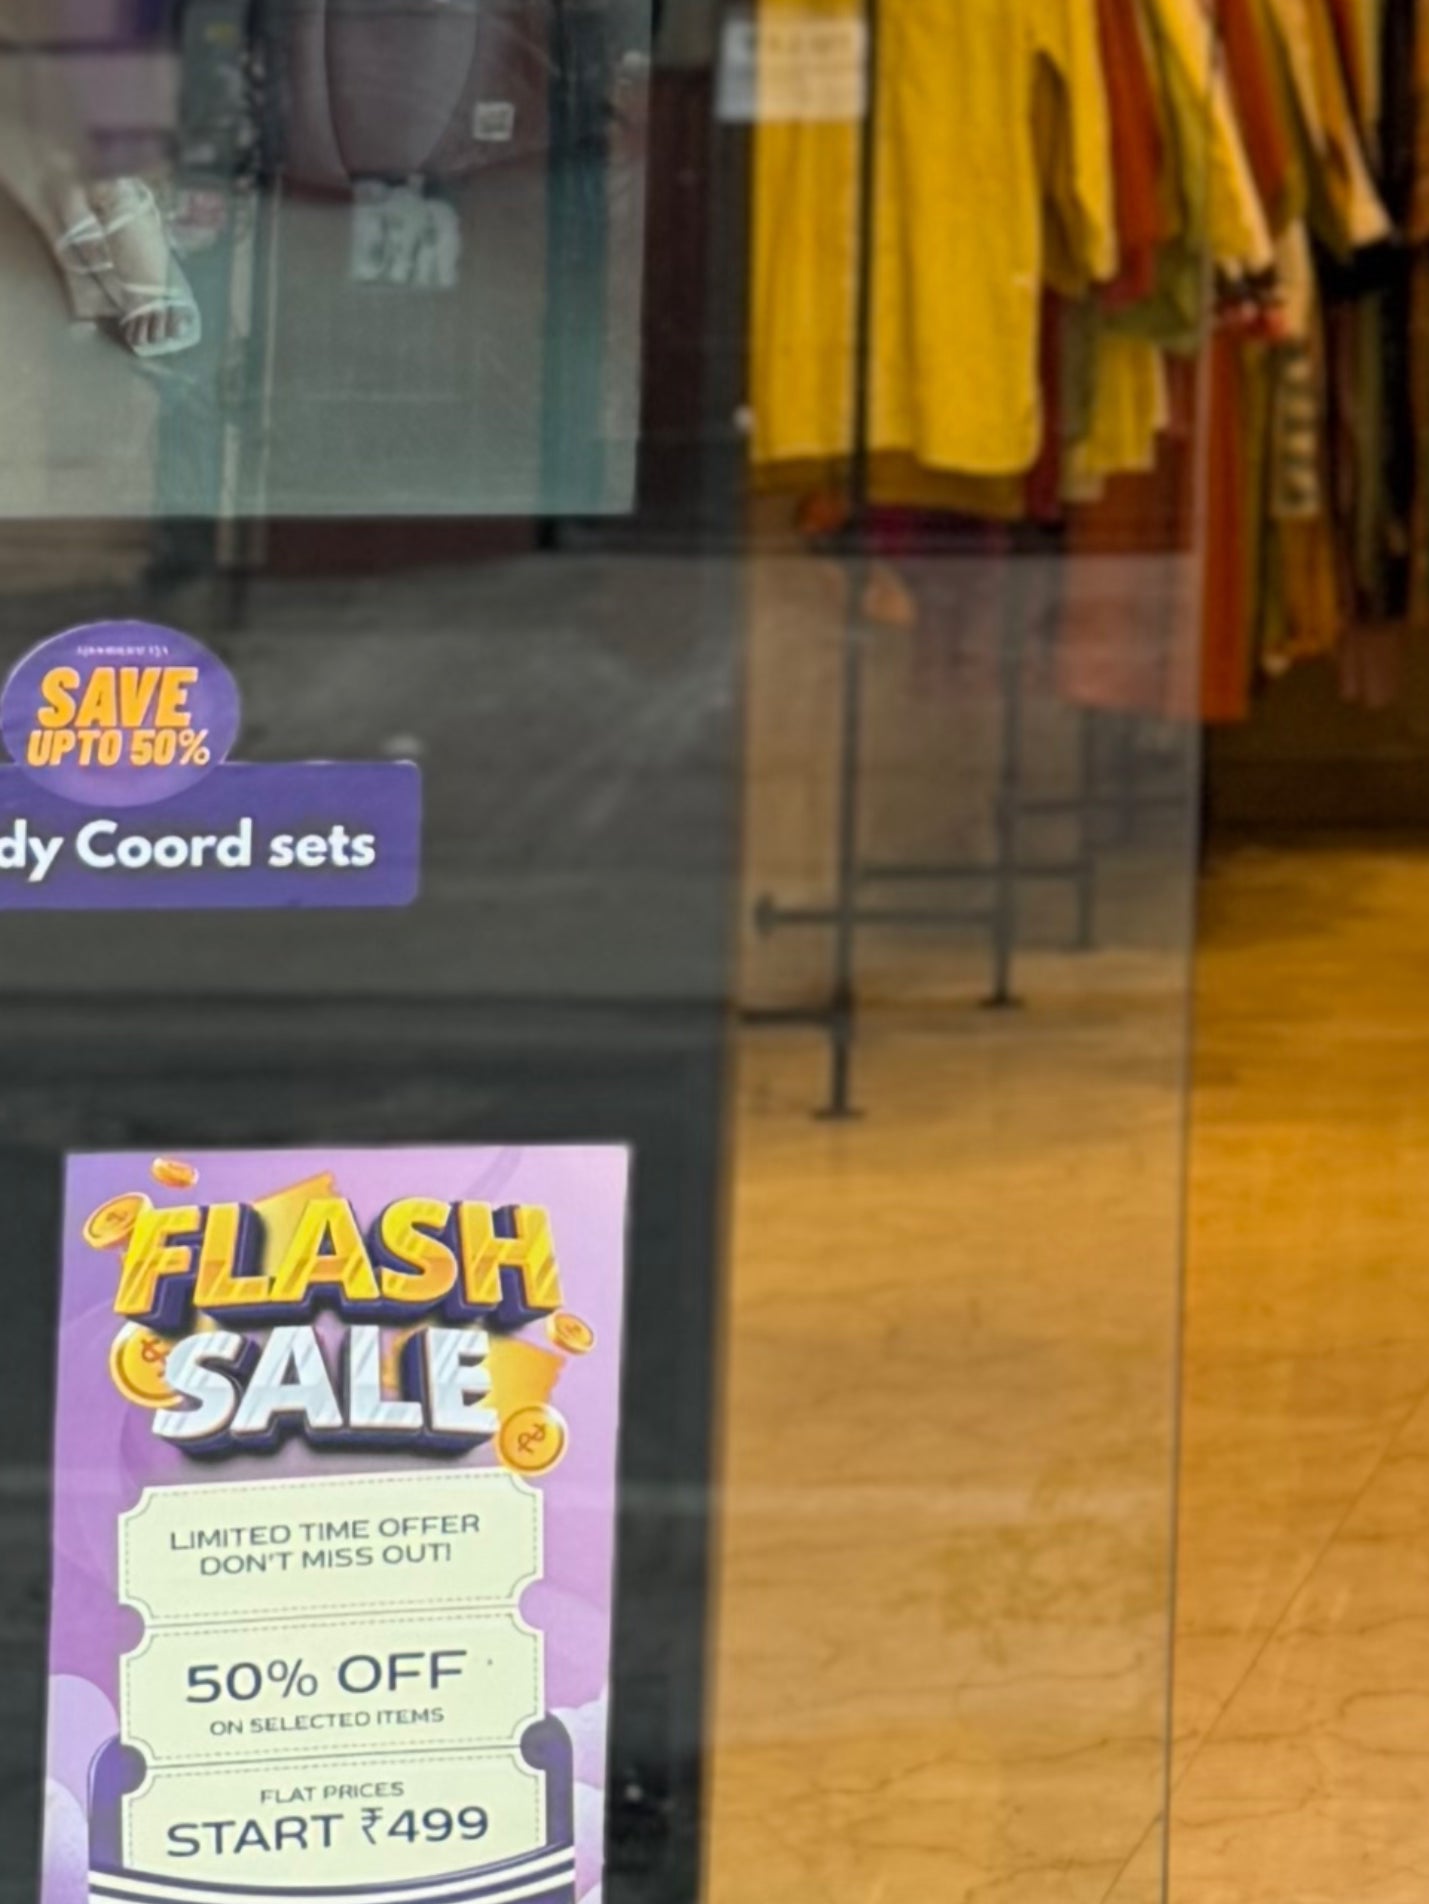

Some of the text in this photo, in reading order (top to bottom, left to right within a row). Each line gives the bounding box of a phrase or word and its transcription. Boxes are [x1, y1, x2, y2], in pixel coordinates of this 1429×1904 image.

[37, 665, 199, 729] SAVE
[130, 729, 211, 767] 50%
[75, 818, 252, 869] Coord
[268, 825, 376, 869] sets
[112, 1196, 564, 1322] FLASH
[150, 1324, 502, 1444] SALE
[170, 1513, 480, 1551] LIMITED TIME OFFER
[200, 1542, 452, 1577] DON'T MISS OUT!
[186, 1649, 467, 1703] 50% OFF
[210, 1707, 445, 1736] ON SELECTED ITEMS
[260, 1781, 405, 1805] FLAT PRICES
[167, 1805, 489, 1858] START ₹499
